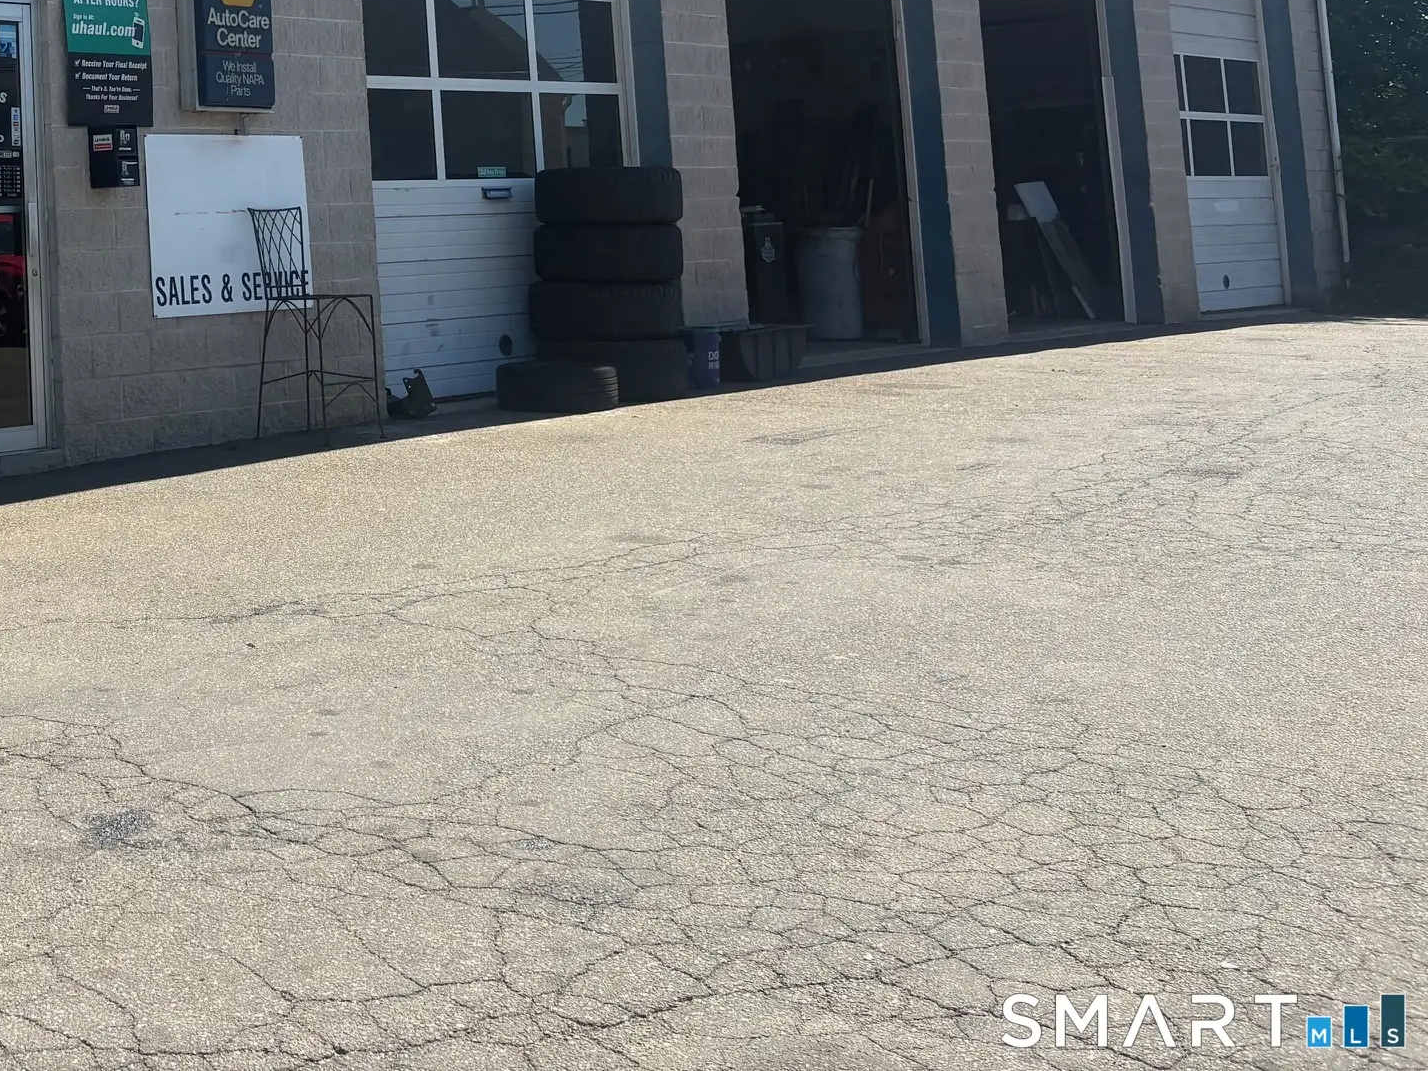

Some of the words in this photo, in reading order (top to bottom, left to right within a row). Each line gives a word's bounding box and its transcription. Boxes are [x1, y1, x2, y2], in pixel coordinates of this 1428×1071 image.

[207, 7, 270, 29] AutoCare
[72, 20, 136, 37] uhaul.com
[216, 29, 262, 48] Center
[82, 59, 102, 68] Receive
[102, 60, 114, 68] Your
[128, 61, 148, 71] Receipt
[222, 60, 236, 72] We
[236, 61, 257, 73] Install
[82, 72, 108, 81] Document
[108, 73, 120, 81] Your
[215, 71, 242, 87] Quality
[242, 73, 265, 86] NAPA
[230, 84, 251, 97] Parts
[155, 274, 213, 307] SALES
[221, 273, 233, 303] &
[241, 270, 311, 302] SERVICE
